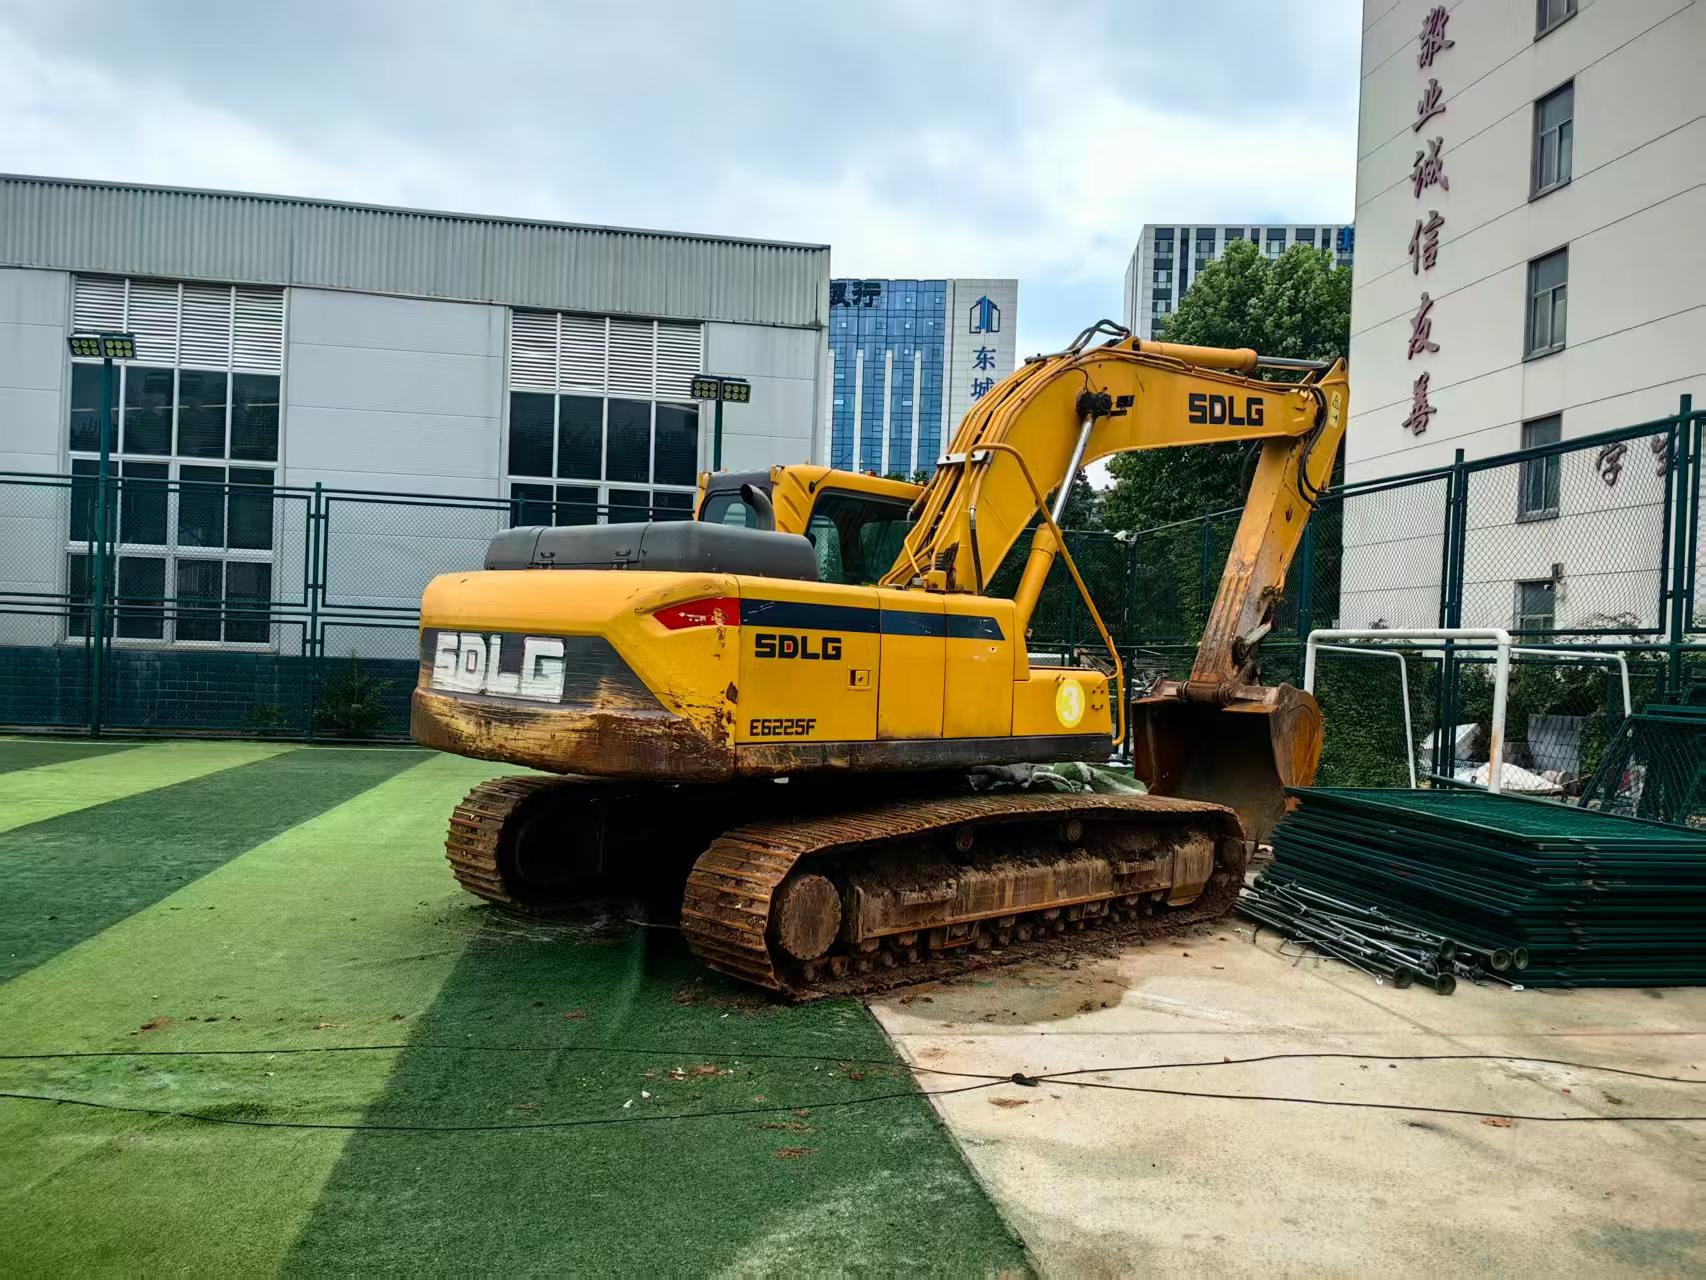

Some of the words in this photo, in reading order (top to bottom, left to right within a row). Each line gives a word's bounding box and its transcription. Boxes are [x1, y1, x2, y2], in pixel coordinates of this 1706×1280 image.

[1402, 5, 1456, 437] 敬业诚信友善
[1188, 393, 1264, 427] SDLG
[755, 633, 842, 660] SDLG
[432, 631, 566, 704] SDLG
[1062, 686, 1080, 721] 3
[750, 718, 816, 736] E6225F
